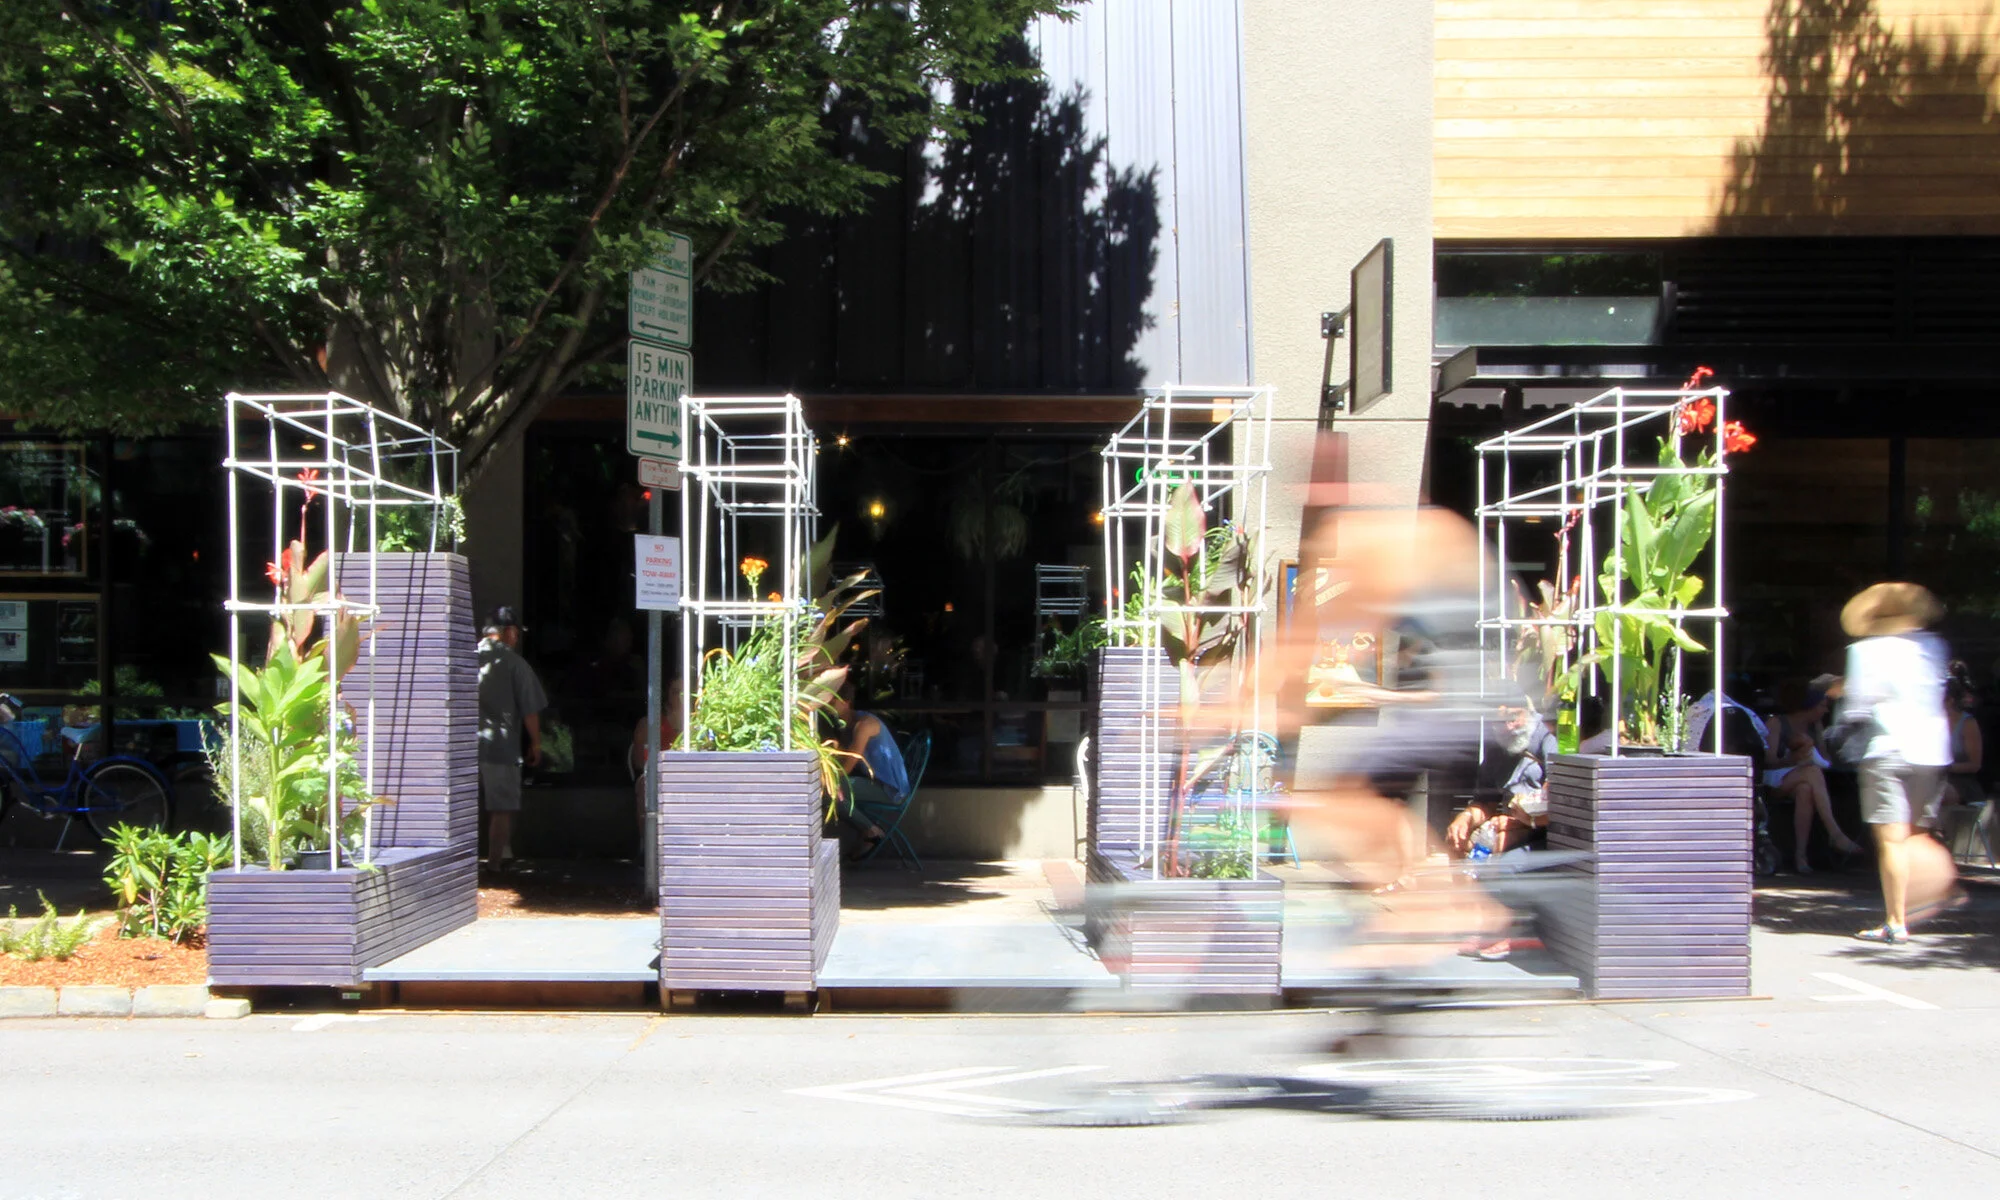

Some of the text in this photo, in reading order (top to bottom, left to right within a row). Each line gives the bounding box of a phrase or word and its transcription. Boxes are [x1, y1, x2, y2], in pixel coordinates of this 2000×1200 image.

[637, 352, 684, 380] 15 MIN
[635, 400, 682, 428] ANYTIM
